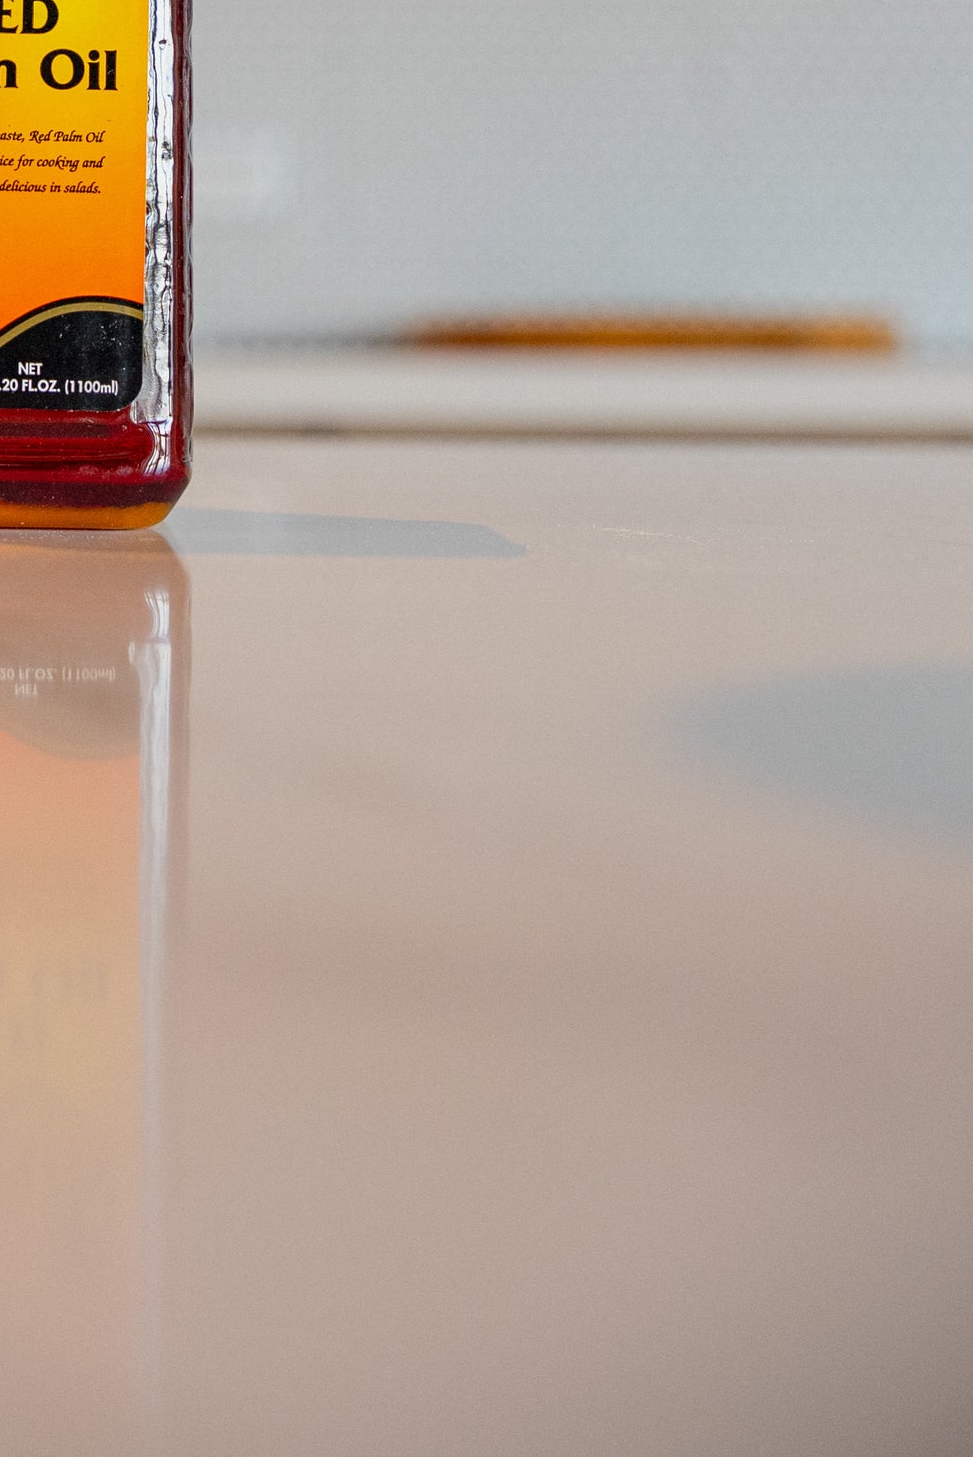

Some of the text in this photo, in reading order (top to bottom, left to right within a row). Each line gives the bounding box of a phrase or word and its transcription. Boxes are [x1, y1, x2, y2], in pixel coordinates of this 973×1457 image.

[39, 48, 118, 91] Oil
[29, 129, 54, 144] Red
[53, 130, 83, 143] Palm
[85, 130, 106, 143] Oil
[14, 154, 35, 171] for
[36, 155, 80, 173] cooking
[82, 155, 106, 168] and
[0, 179, 47, 192] delicious
[50, 181, 61, 193] in
[63, 180, 101, 194] salads.
[17, 362, 43, 375] NET
[21, 379, 61, 393] FL.OZ.
[64, 379, 119, 396] (1100ml)
